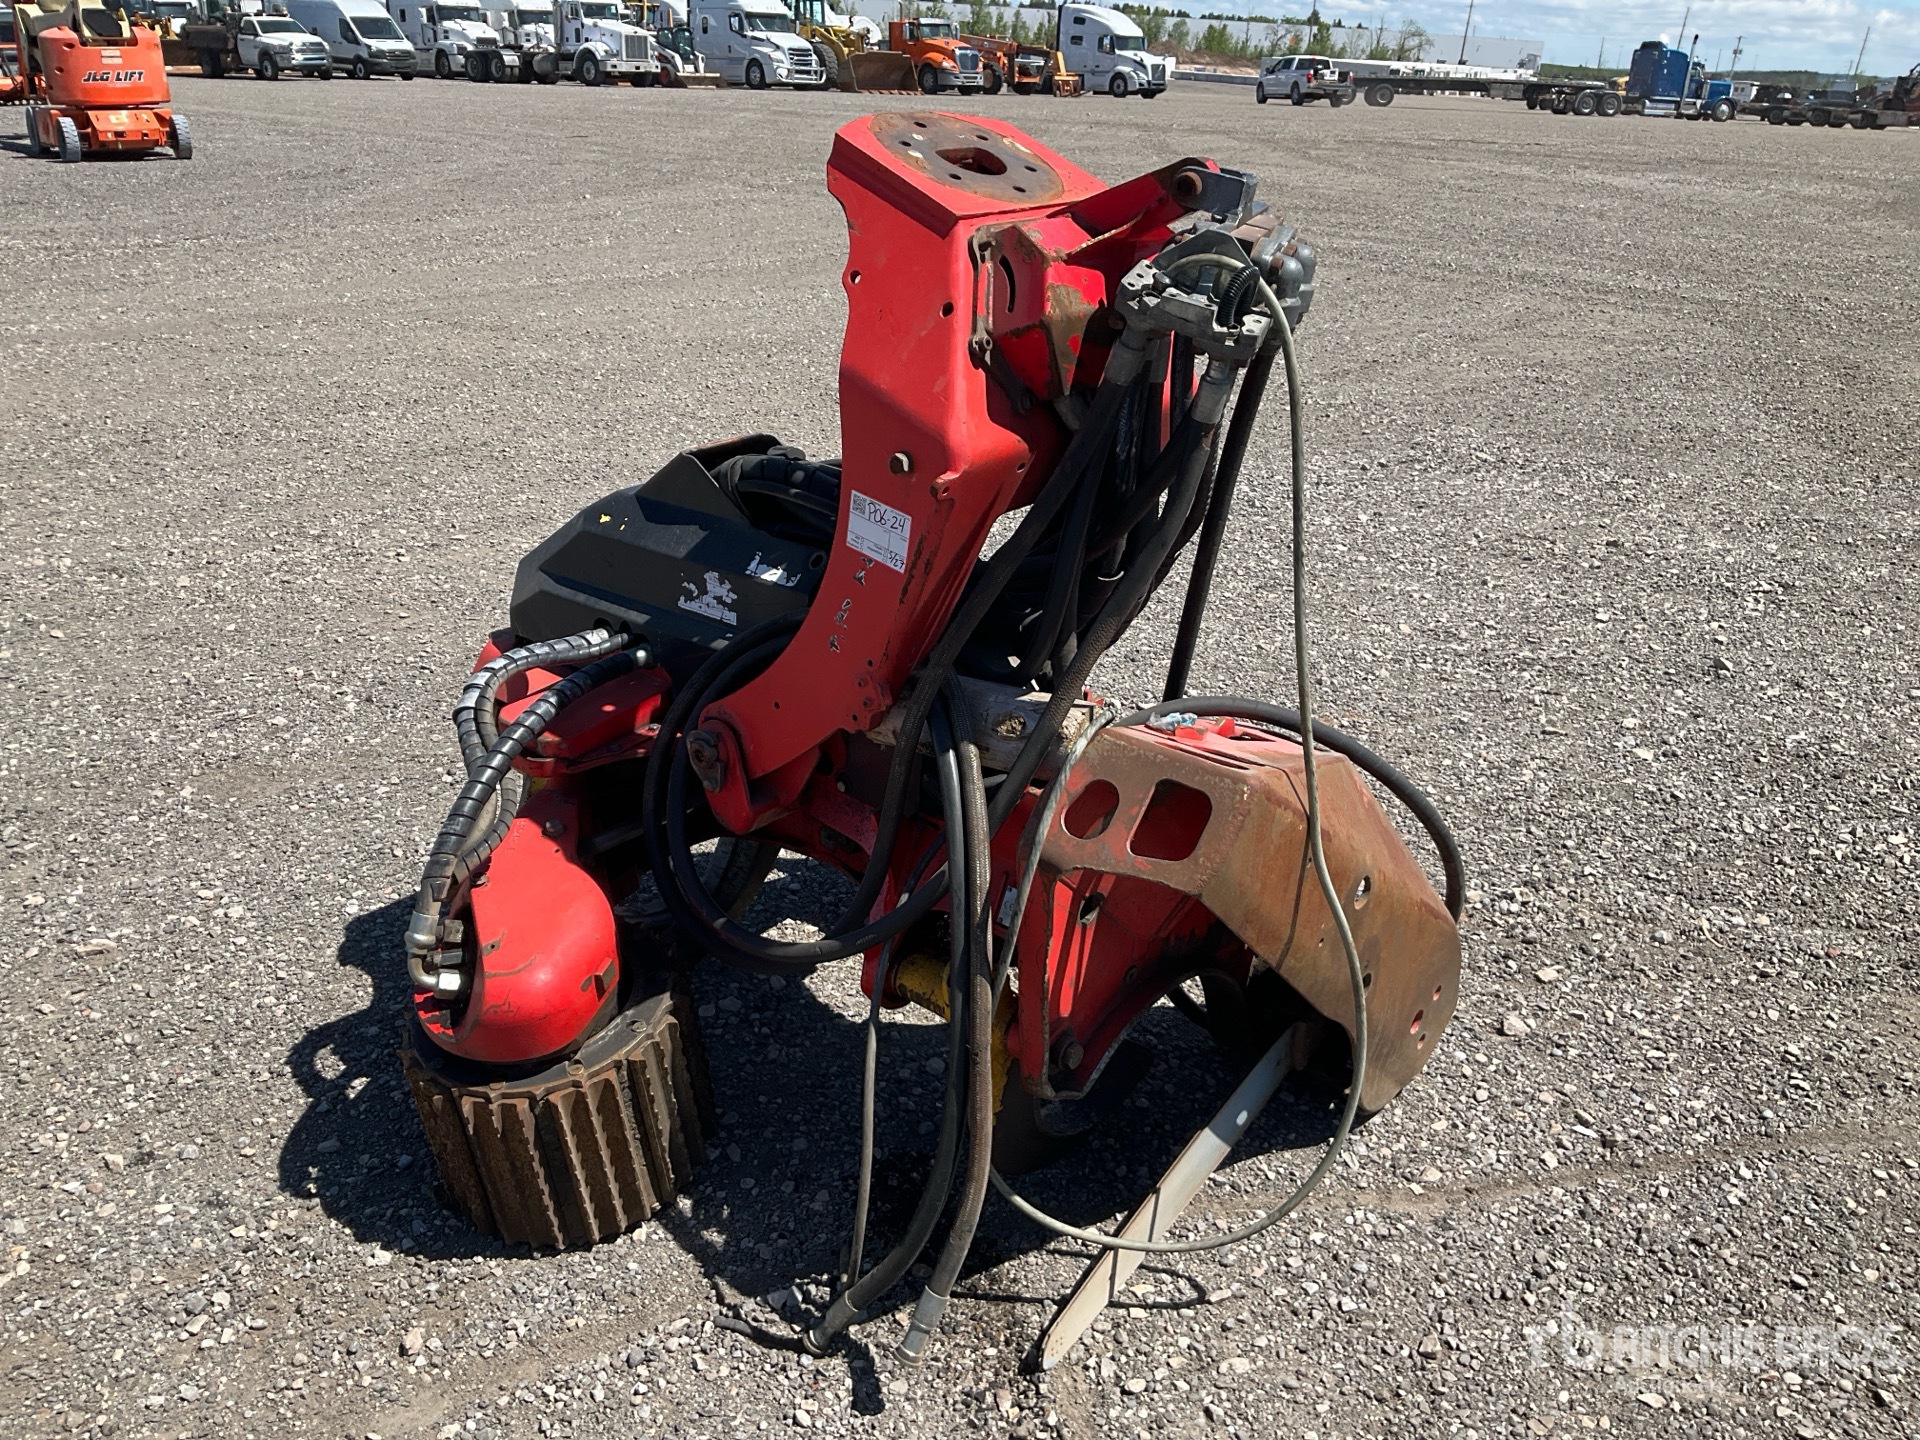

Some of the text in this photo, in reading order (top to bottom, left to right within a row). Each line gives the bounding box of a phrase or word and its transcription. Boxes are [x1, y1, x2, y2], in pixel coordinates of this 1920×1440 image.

[82, 70, 145, 83] JLG LIFT
[867, 502, 906, 533] P06-24
[888, 550, 904, 569] 5/27
